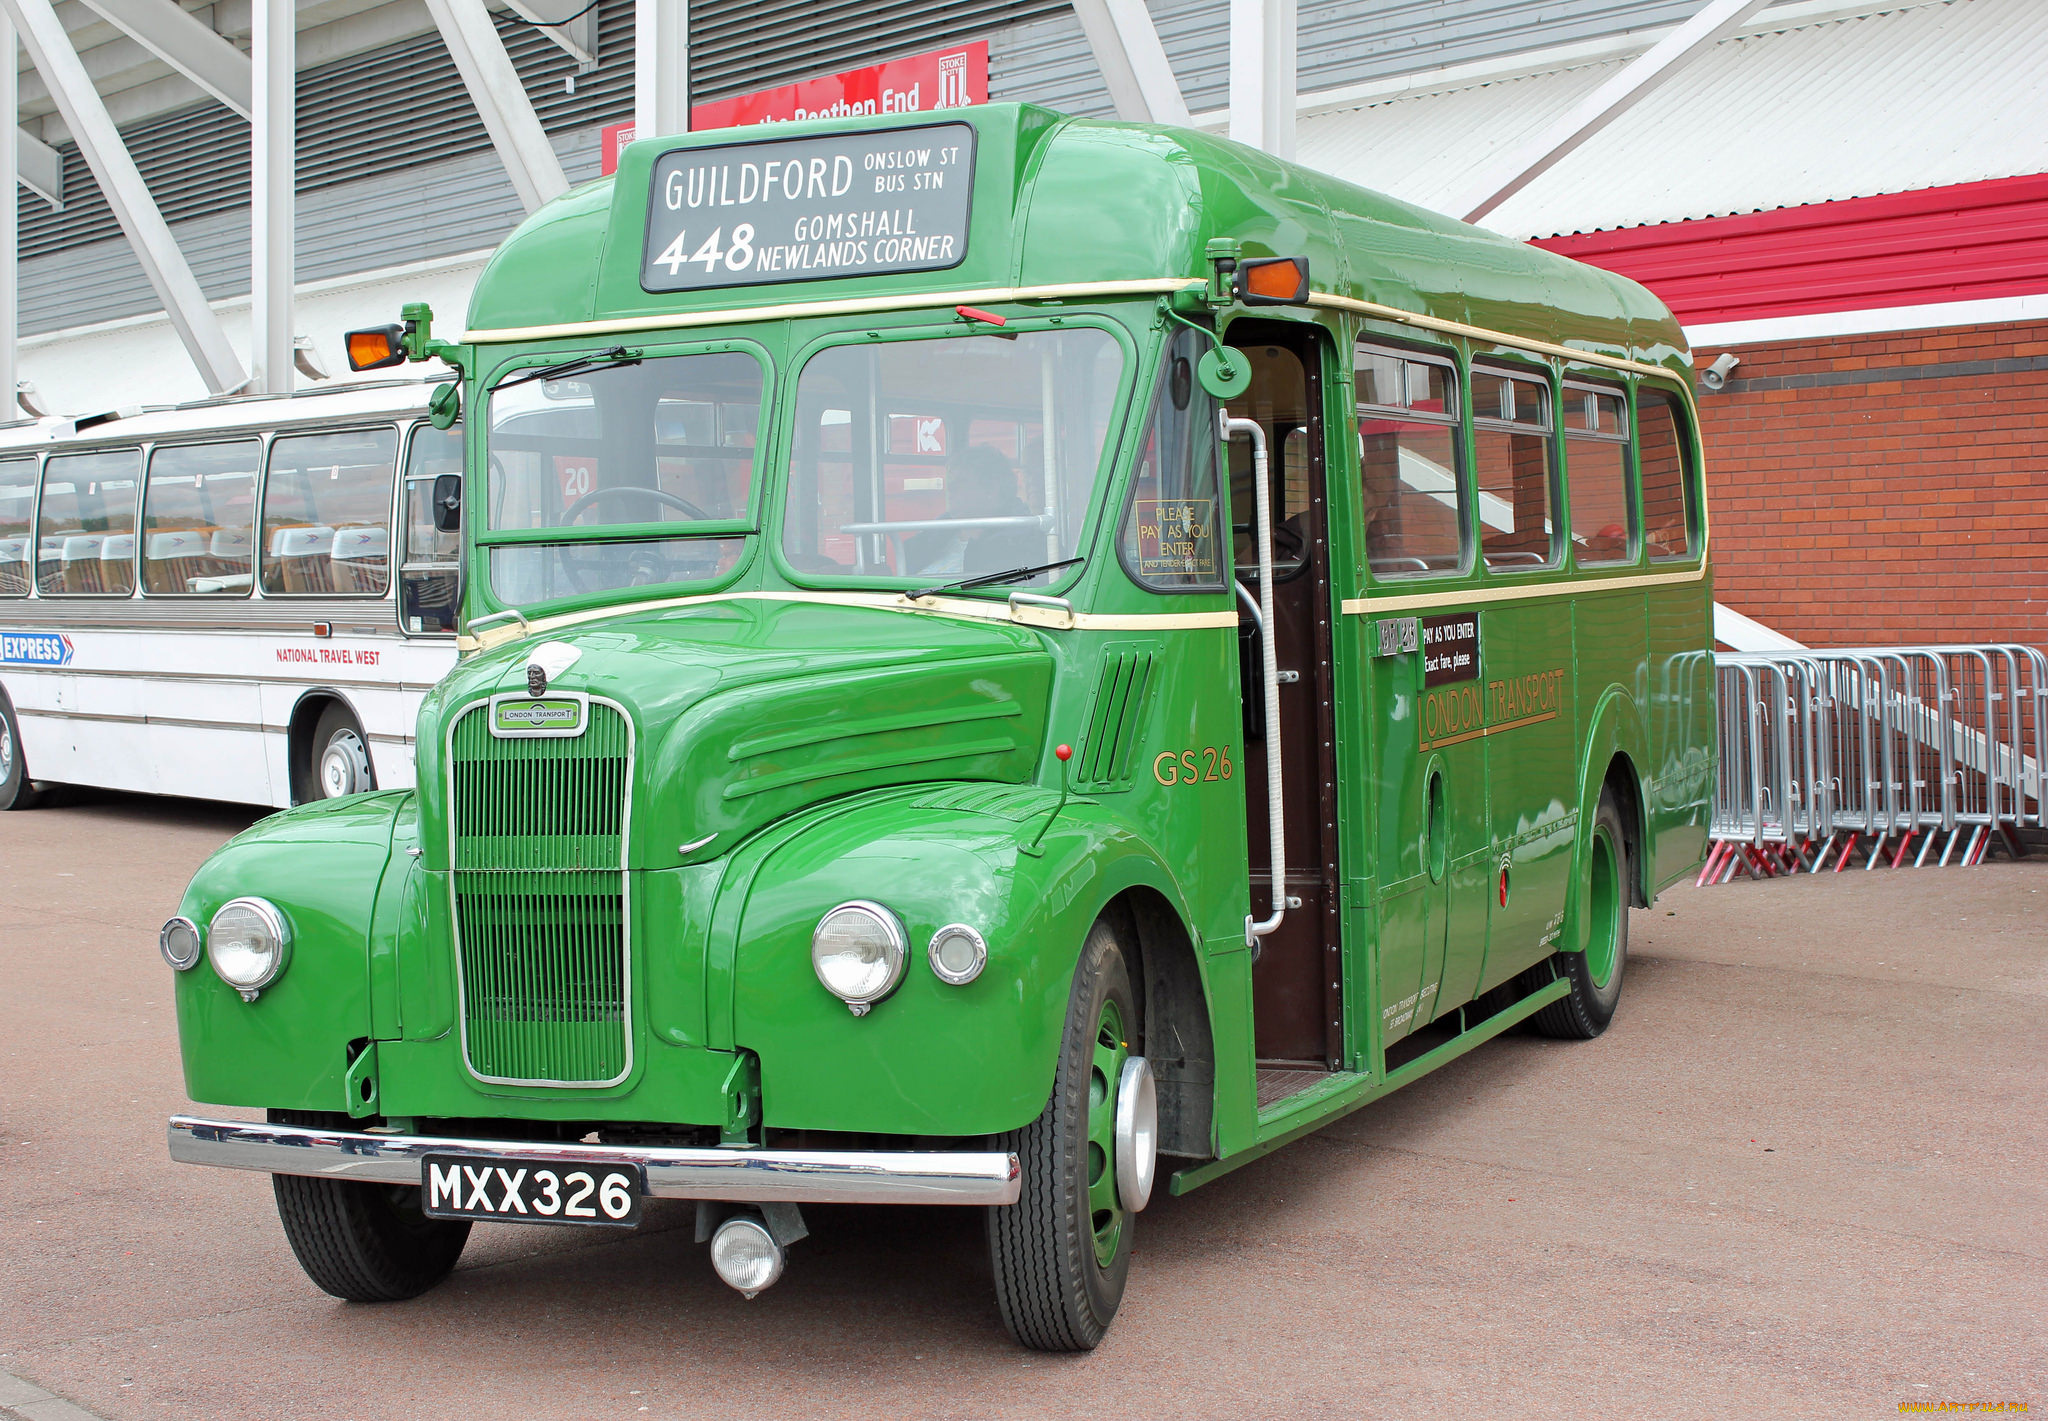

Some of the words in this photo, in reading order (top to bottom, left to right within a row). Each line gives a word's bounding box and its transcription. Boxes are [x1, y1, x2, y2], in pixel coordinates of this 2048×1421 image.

[941, 57, 965, 70] STOKE
[946, 67, 960, 76] CITY
[882, 82, 920, 114] End
[864, 148, 932, 170] ONSLOW
[940, 147, 959, 166] ST
[665, 155, 853, 210] GUILDFORD
[875, 173, 905, 193] BUS
[913, 172, 944, 191] STN
[794, 209, 917, 242] GOMSHALL
[652, 223, 755, 275] 448
[756, 240, 867, 272] NEWLANDS
[873, 235, 954, 263] CORNER
[565, 467, 590, 496] 20
[1141, 524, 1162, 539] PAY
[1167, 525, 1182, 539] AS
[1188, 524, 1210, 539] YOU
[1160, 541, 1195, 556] ENTER
[1423, 627, 1434, 645] PAY
[1435, 626, 1443, 643] AS
[1443, 624, 1456, 642] YOU
[1457, 621, 1475, 640] ENTER
[3, 636, 61, 661] EXPRESS
[276, 648, 318, 663] NATIONAL
[319, 649, 354, 664] TRAVEL
[355, 650, 380, 665] WEST
[1424, 656, 1440, 673] Exact
[1453, 650, 1471, 672] please
[503, 710, 533, 720] LONDON
[534, 709, 572, 720] TRANSPORT
[1416, 686, 1484, 753] LONDON
[1489, 668, 1565, 723] TRANSPORT
[1153, 745, 1233, 787] GS26
[429, 1163, 632, 1220] MXX326
